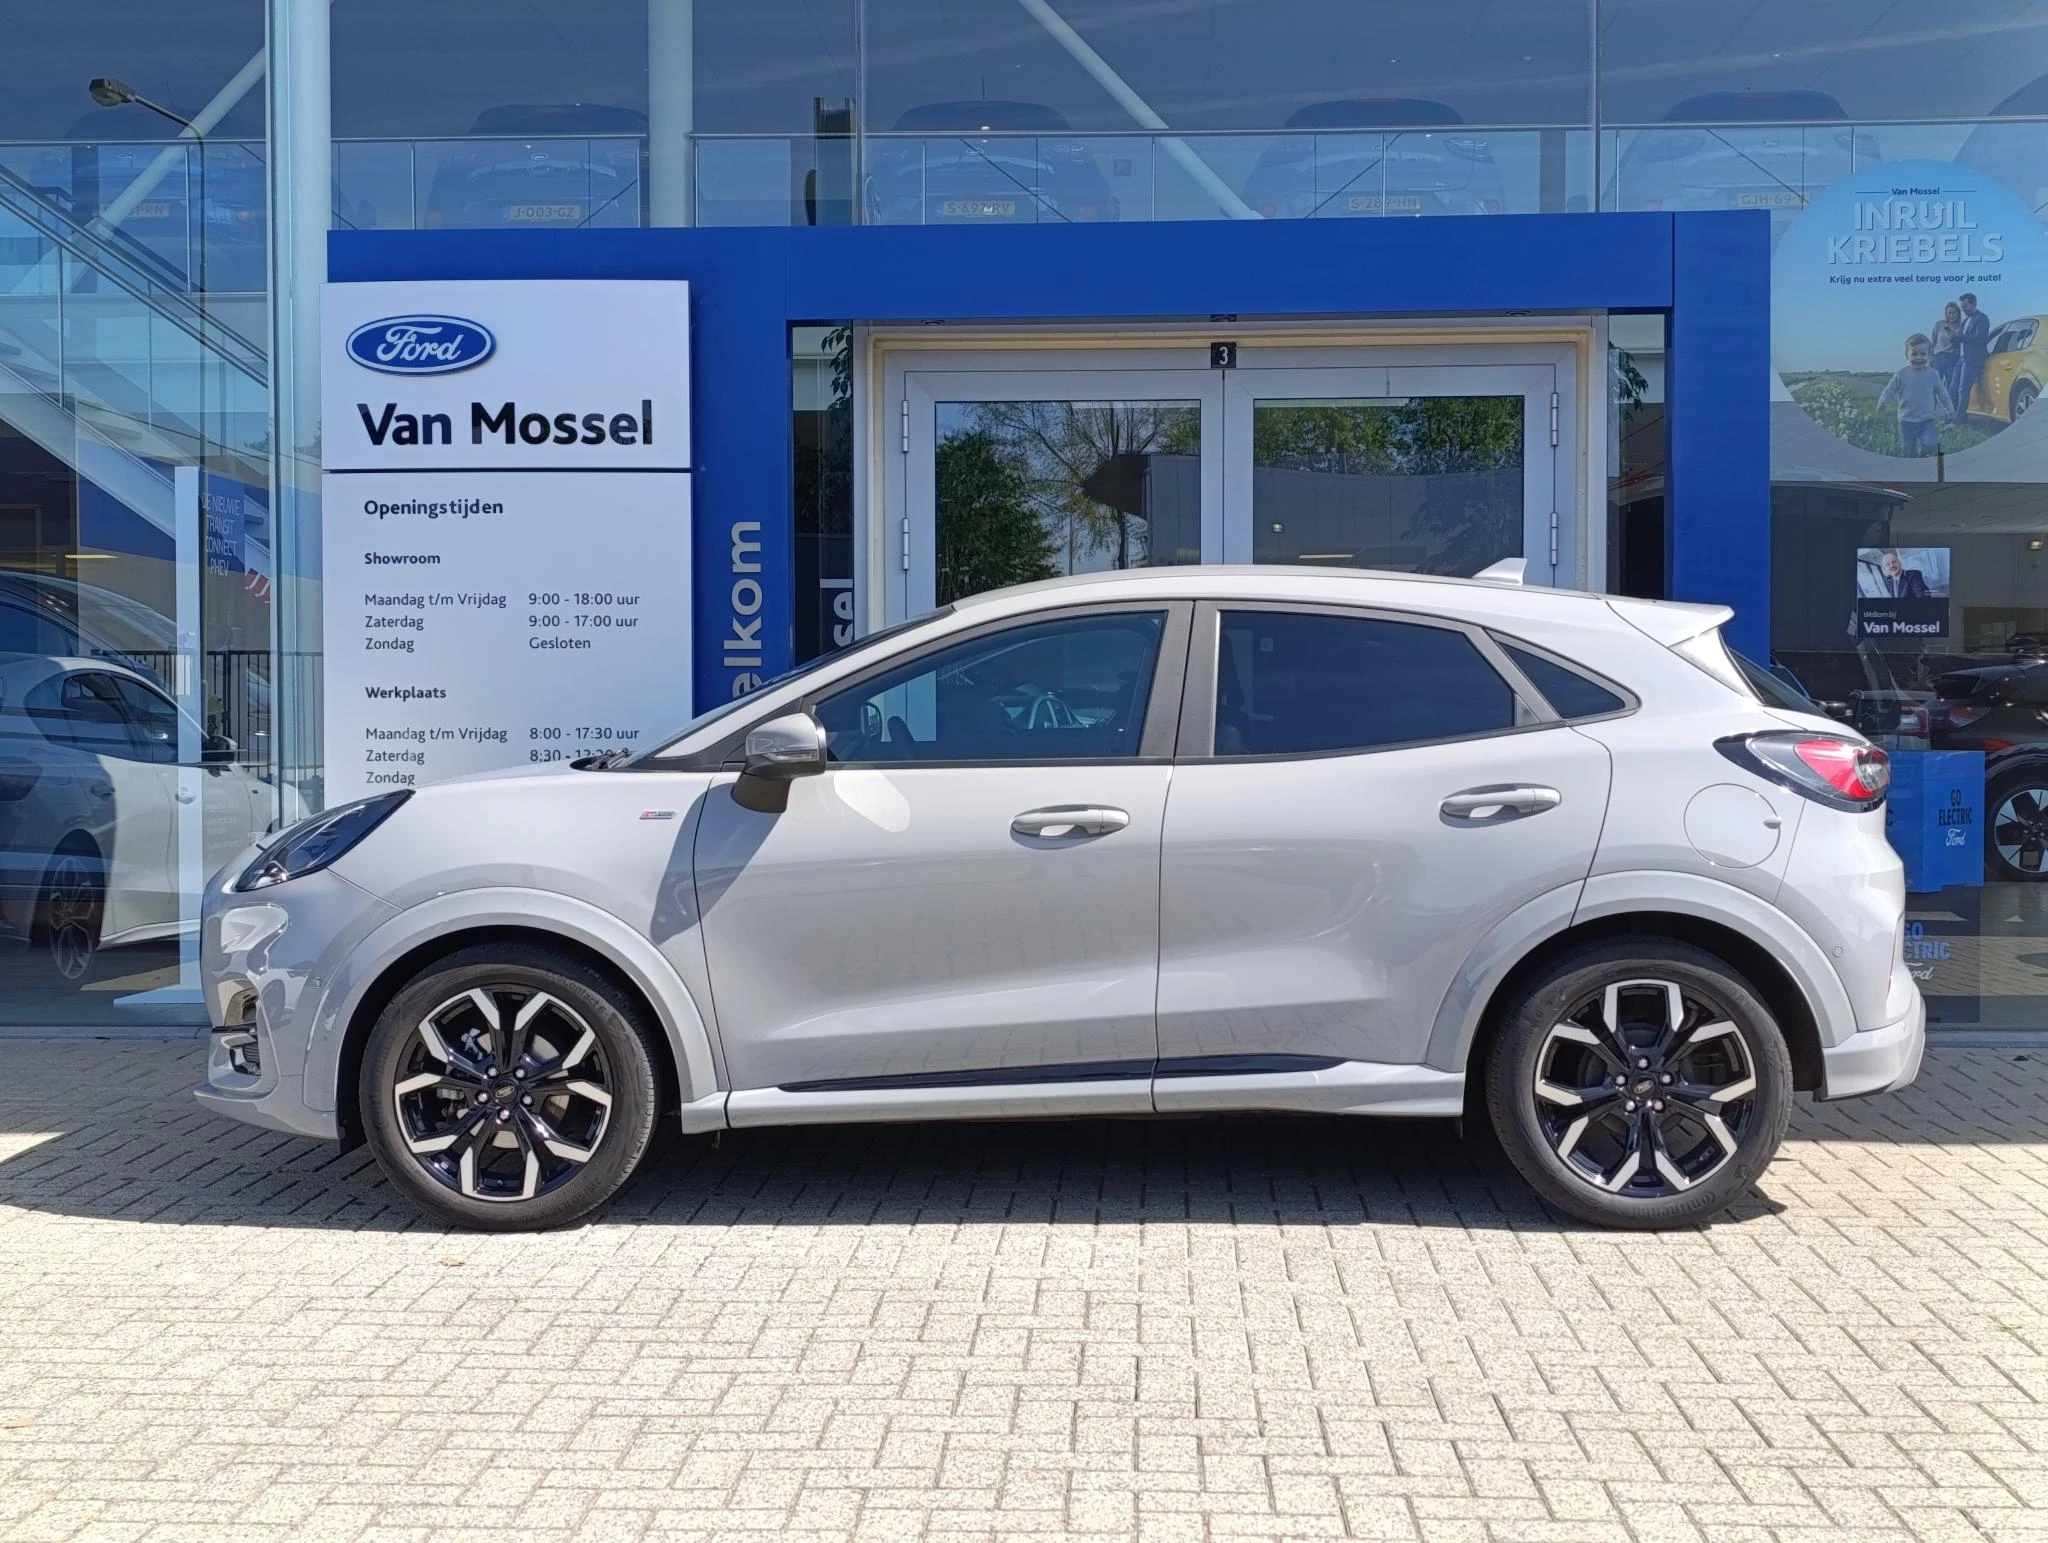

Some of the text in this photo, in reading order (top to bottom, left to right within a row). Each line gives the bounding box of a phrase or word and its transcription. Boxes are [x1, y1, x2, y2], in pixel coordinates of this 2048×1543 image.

[1742, 192, 1810, 205] GJH-69-
[1891, 186, 1940, 196] Van Mossel
[1853, 200, 1978, 231] INRUIL
[1827, 233, 2005, 265] KRIEBELS
[1829, 273, 2002, 286] Krijg nu extra veel terug voor je auto!
[377, 325, 465, 362] Ford
[1219, 346, 1229, 365] 3
[356, 399, 654, 446] Van Mossel
[212, 494, 241, 517] NIEUWE
[363, 498, 504, 520] Openingstijden
[205, 535, 237, 557] CONNECT
[210, 557, 230, 577] PHEV
[364, 551, 441, 565] Showroom
[364, 592, 507, 610] Maandag t/m Vrijdag
[528, 592, 560, 606] 9:00
[573, 592, 613, 606] 18:00
[616, 595, 641, 606] uur
[364, 614, 424, 632] Zaterdag
[528, 614, 561, 628] 9:00
[573, 614, 612, 628] 17:00
[615, 617, 639, 628] uur
[1863, 620, 1940, 634] Van Mossel
[365, 636, 415, 653] Zondag
[528, 636, 592, 650] Gesloten
[364, 685, 447, 703] Werkplaats
[365, 727, 509, 744] Maandag t/m Vrijdag
[529, 727, 562, 740] 8:00
[575, 727, 613, 740] 17:30
[616, 729, 640, 740] uur
[365, 748, 425, 766] Zaterdag
[529, 749, 561, 762] 8:30
[365, 770, 416, 786] Zondag
[1950, 789, 1962, 807] GO
[1938, 808, 1973, 826] ELECTRIC
[1945, 828, 1966, 847] Ford
